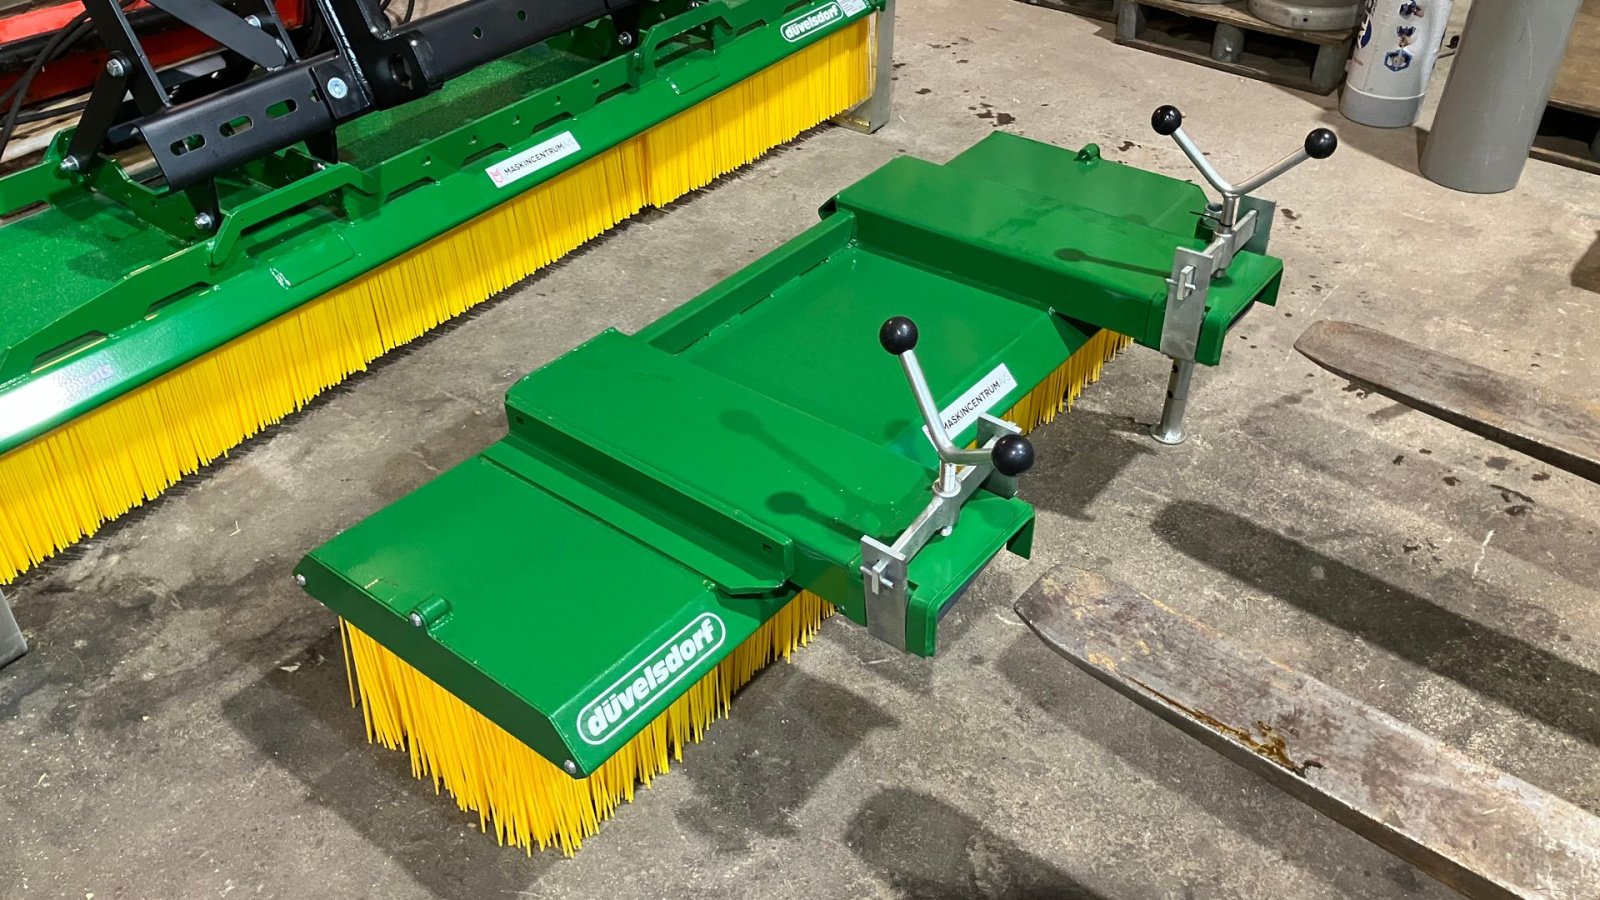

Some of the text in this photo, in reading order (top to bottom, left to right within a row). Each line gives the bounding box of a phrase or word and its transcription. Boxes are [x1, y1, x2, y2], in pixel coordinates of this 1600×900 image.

[785, 4, 838, 39] düvelsdorf
[504, 143, 564, 176] MASKINCENTRUM
[587, 618, 715, 736] düvelsdorf
